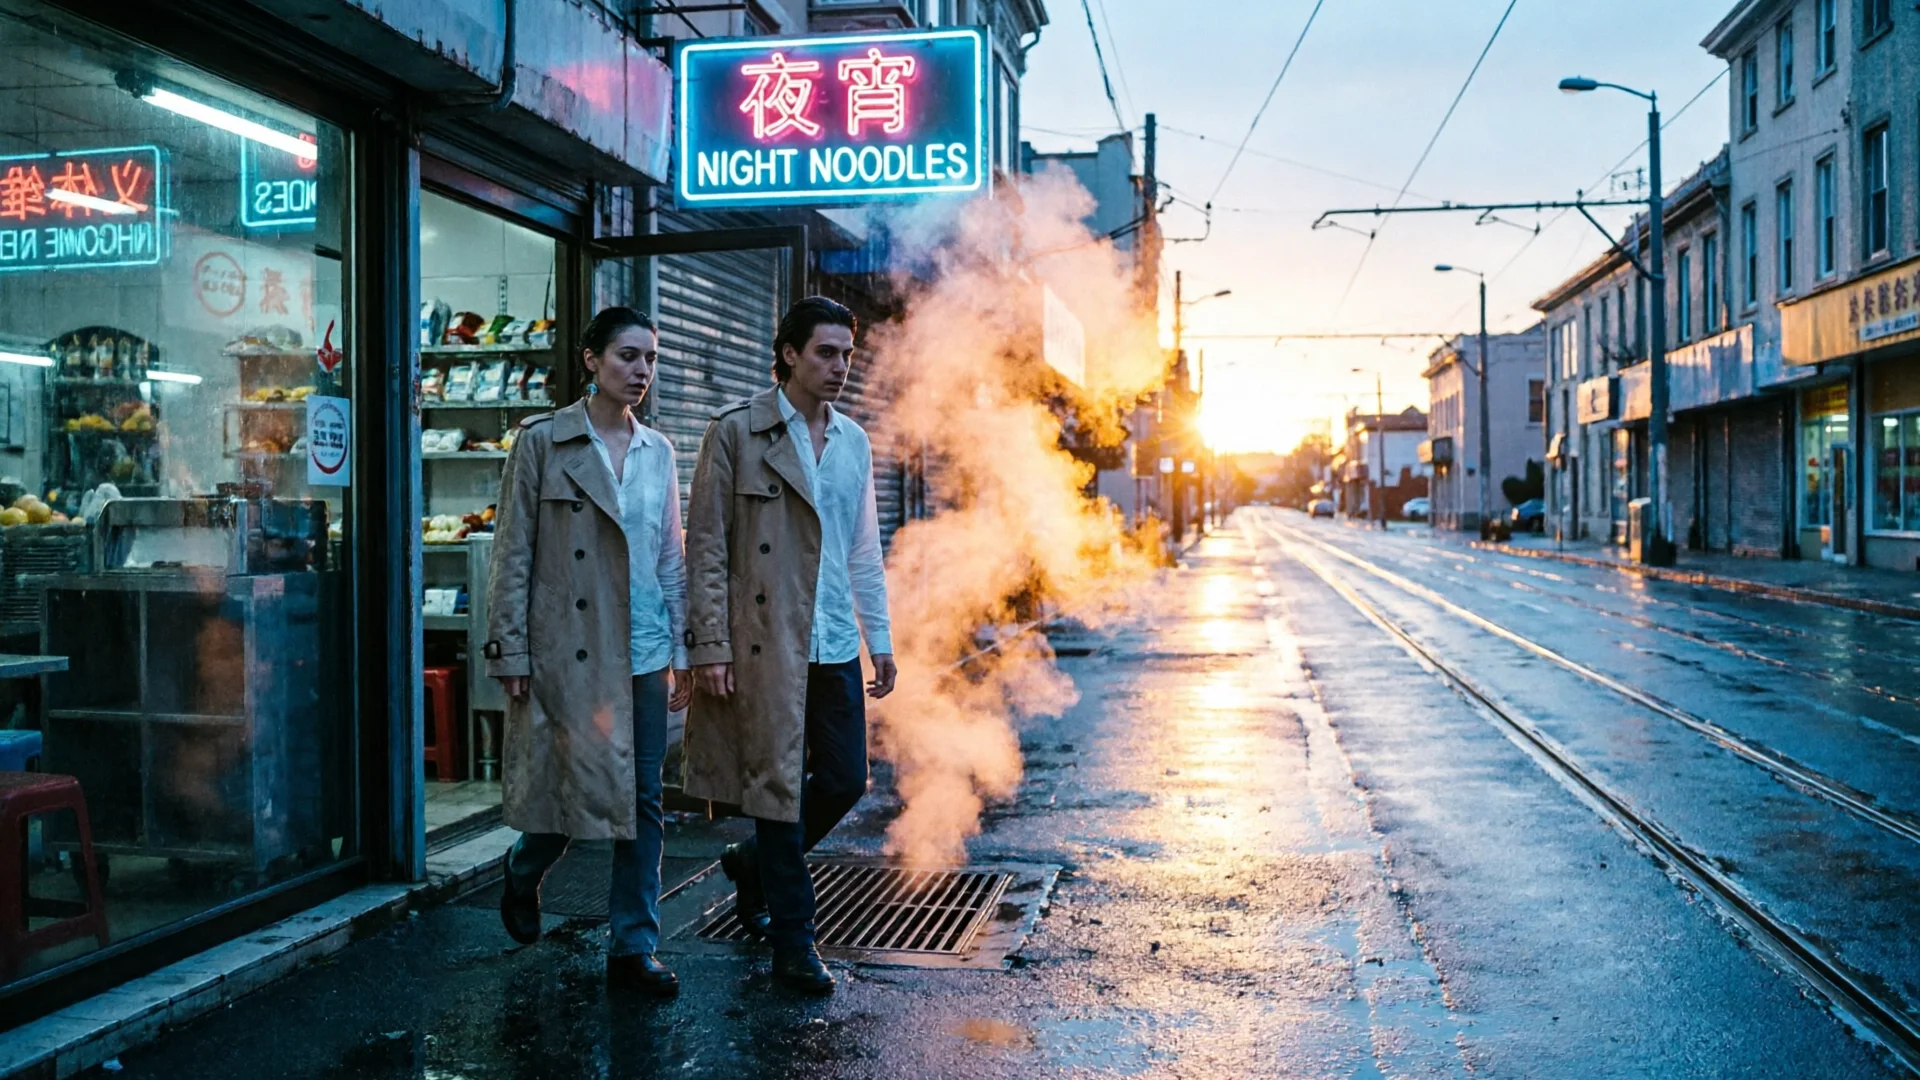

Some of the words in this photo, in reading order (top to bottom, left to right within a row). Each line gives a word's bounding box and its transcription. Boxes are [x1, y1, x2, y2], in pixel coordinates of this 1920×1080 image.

[739, 47, 915, 139] 夜宵
[698, 148, 798, 187] NIGHT
[809, 142, 968, 183] NOODLES
